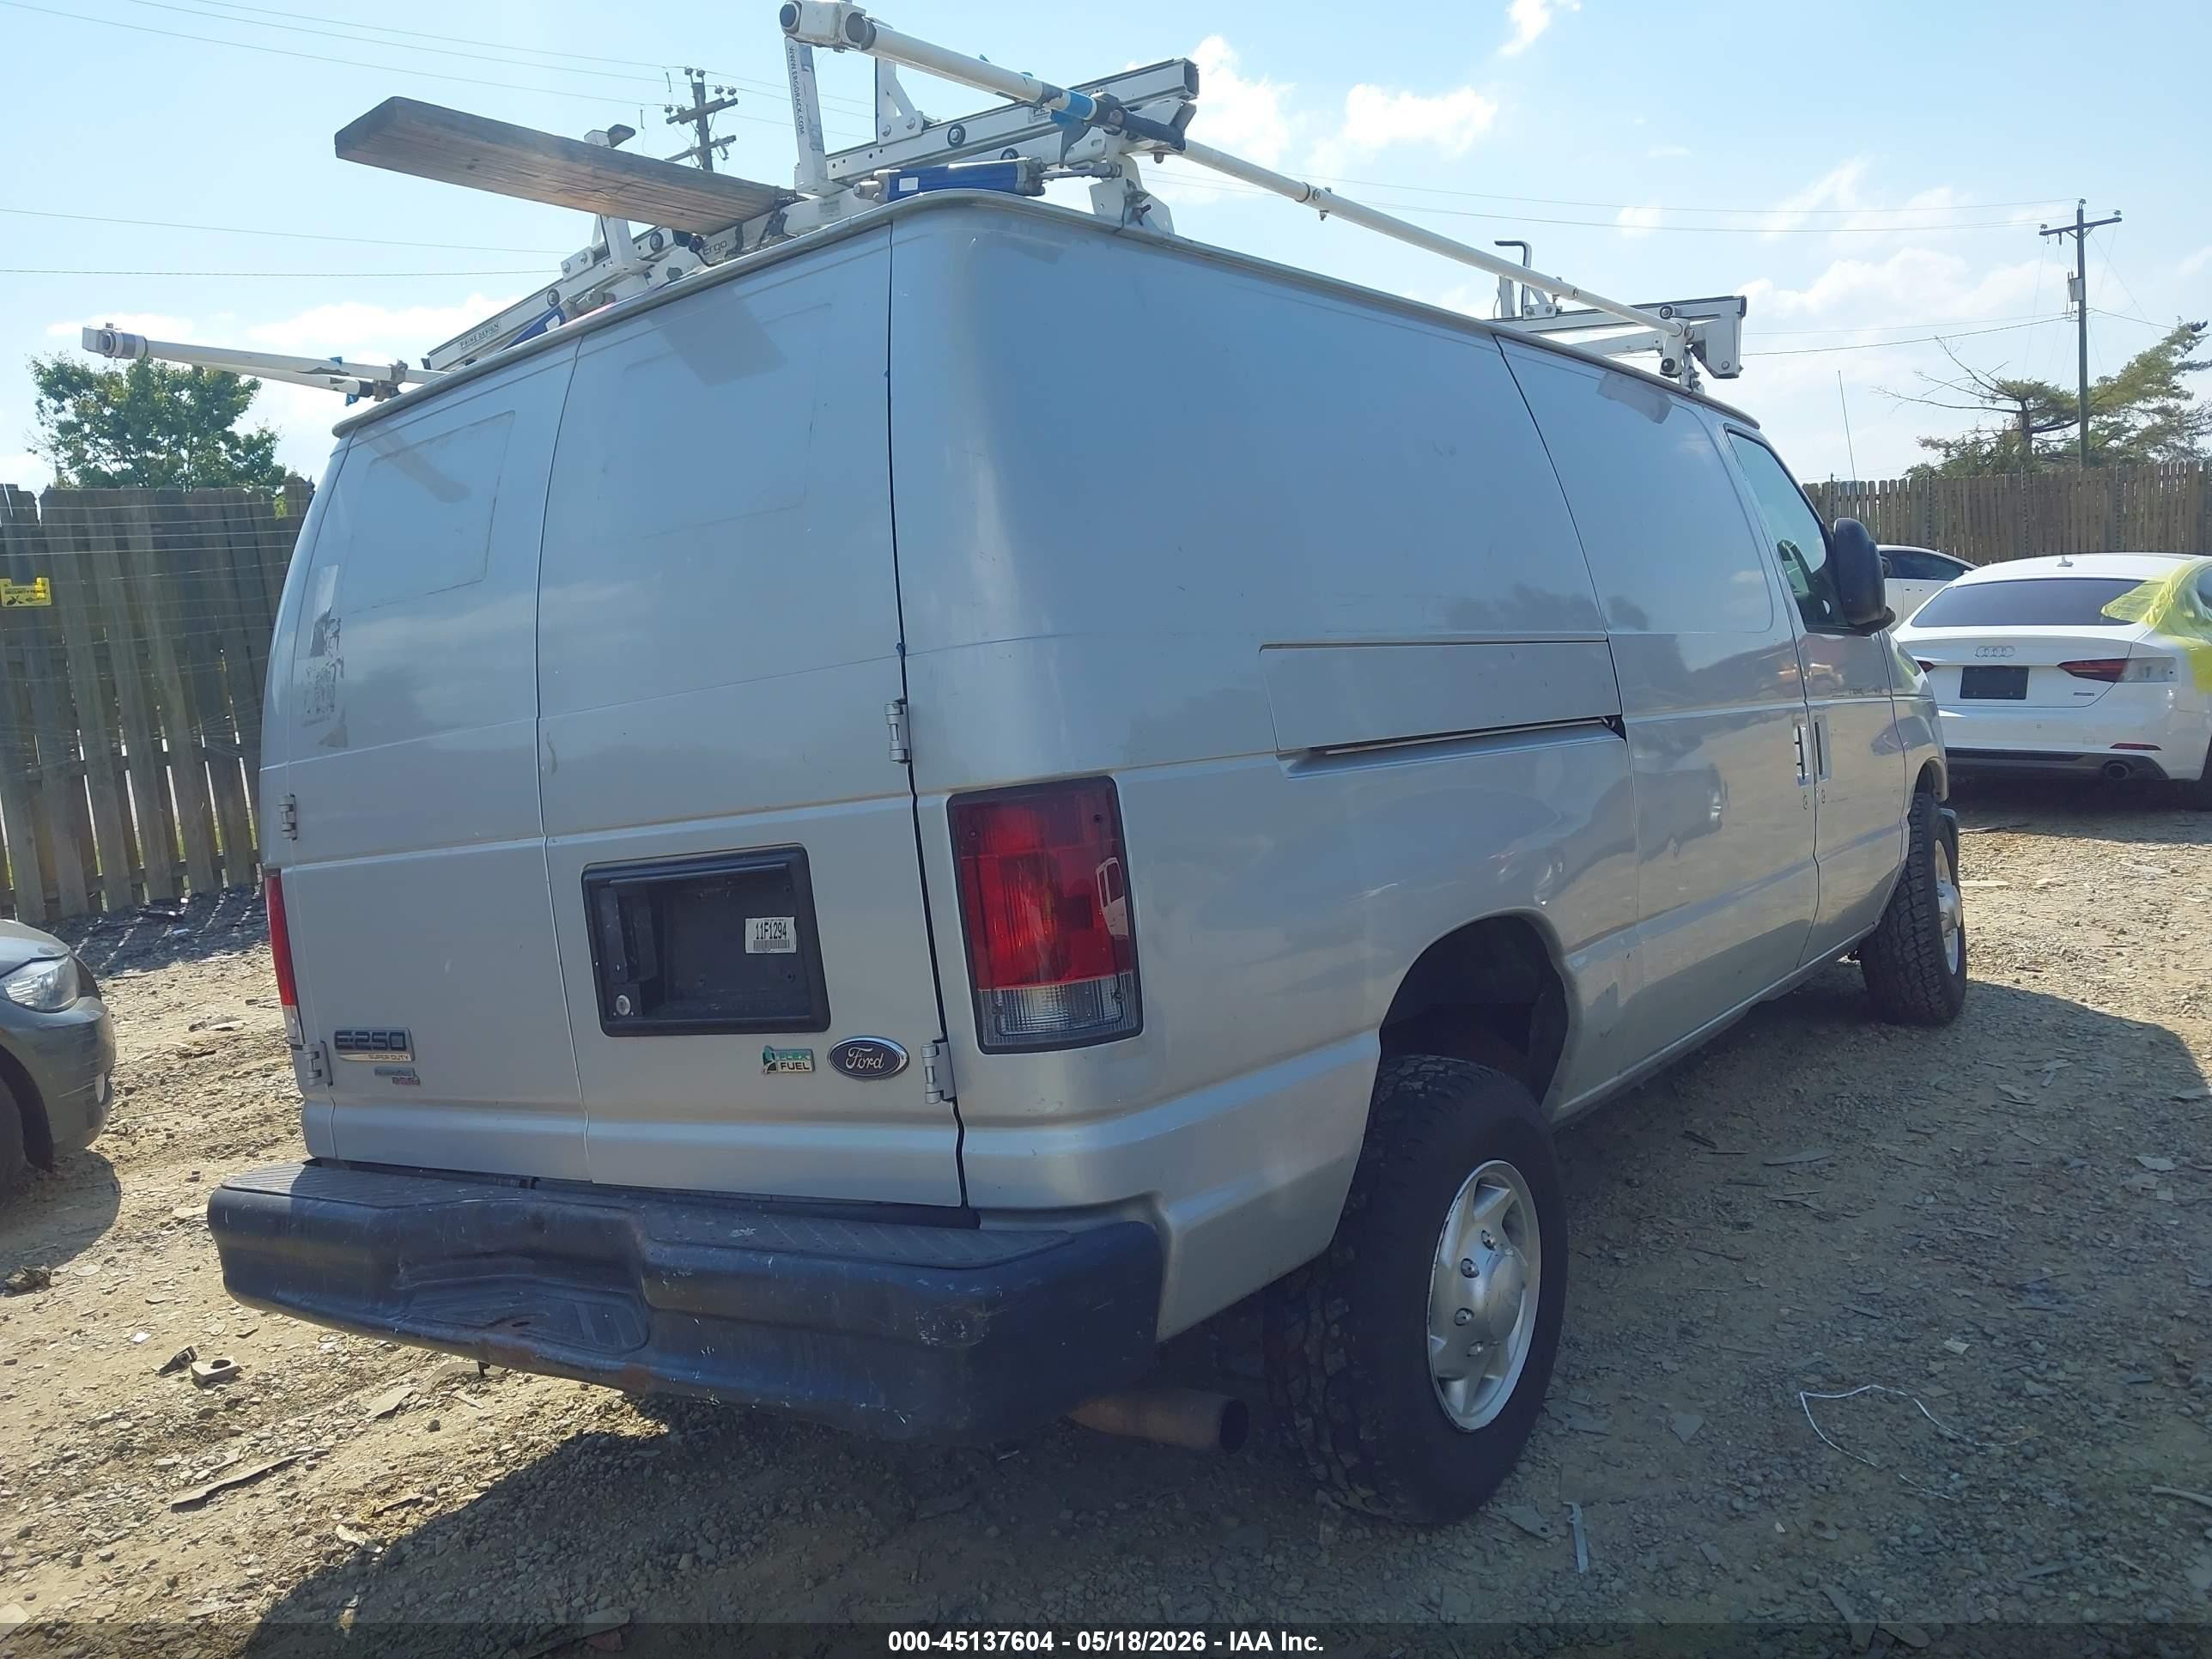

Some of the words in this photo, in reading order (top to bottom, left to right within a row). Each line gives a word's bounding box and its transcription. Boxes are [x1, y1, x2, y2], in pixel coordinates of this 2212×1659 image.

[789, 46, 805, 135] WWW.ERGORACK.COM
[702, 241, 727, 255] Ergo
[756, 921, 787, 939] 11F1294
[845, 1047, 885, 1069] Ford
